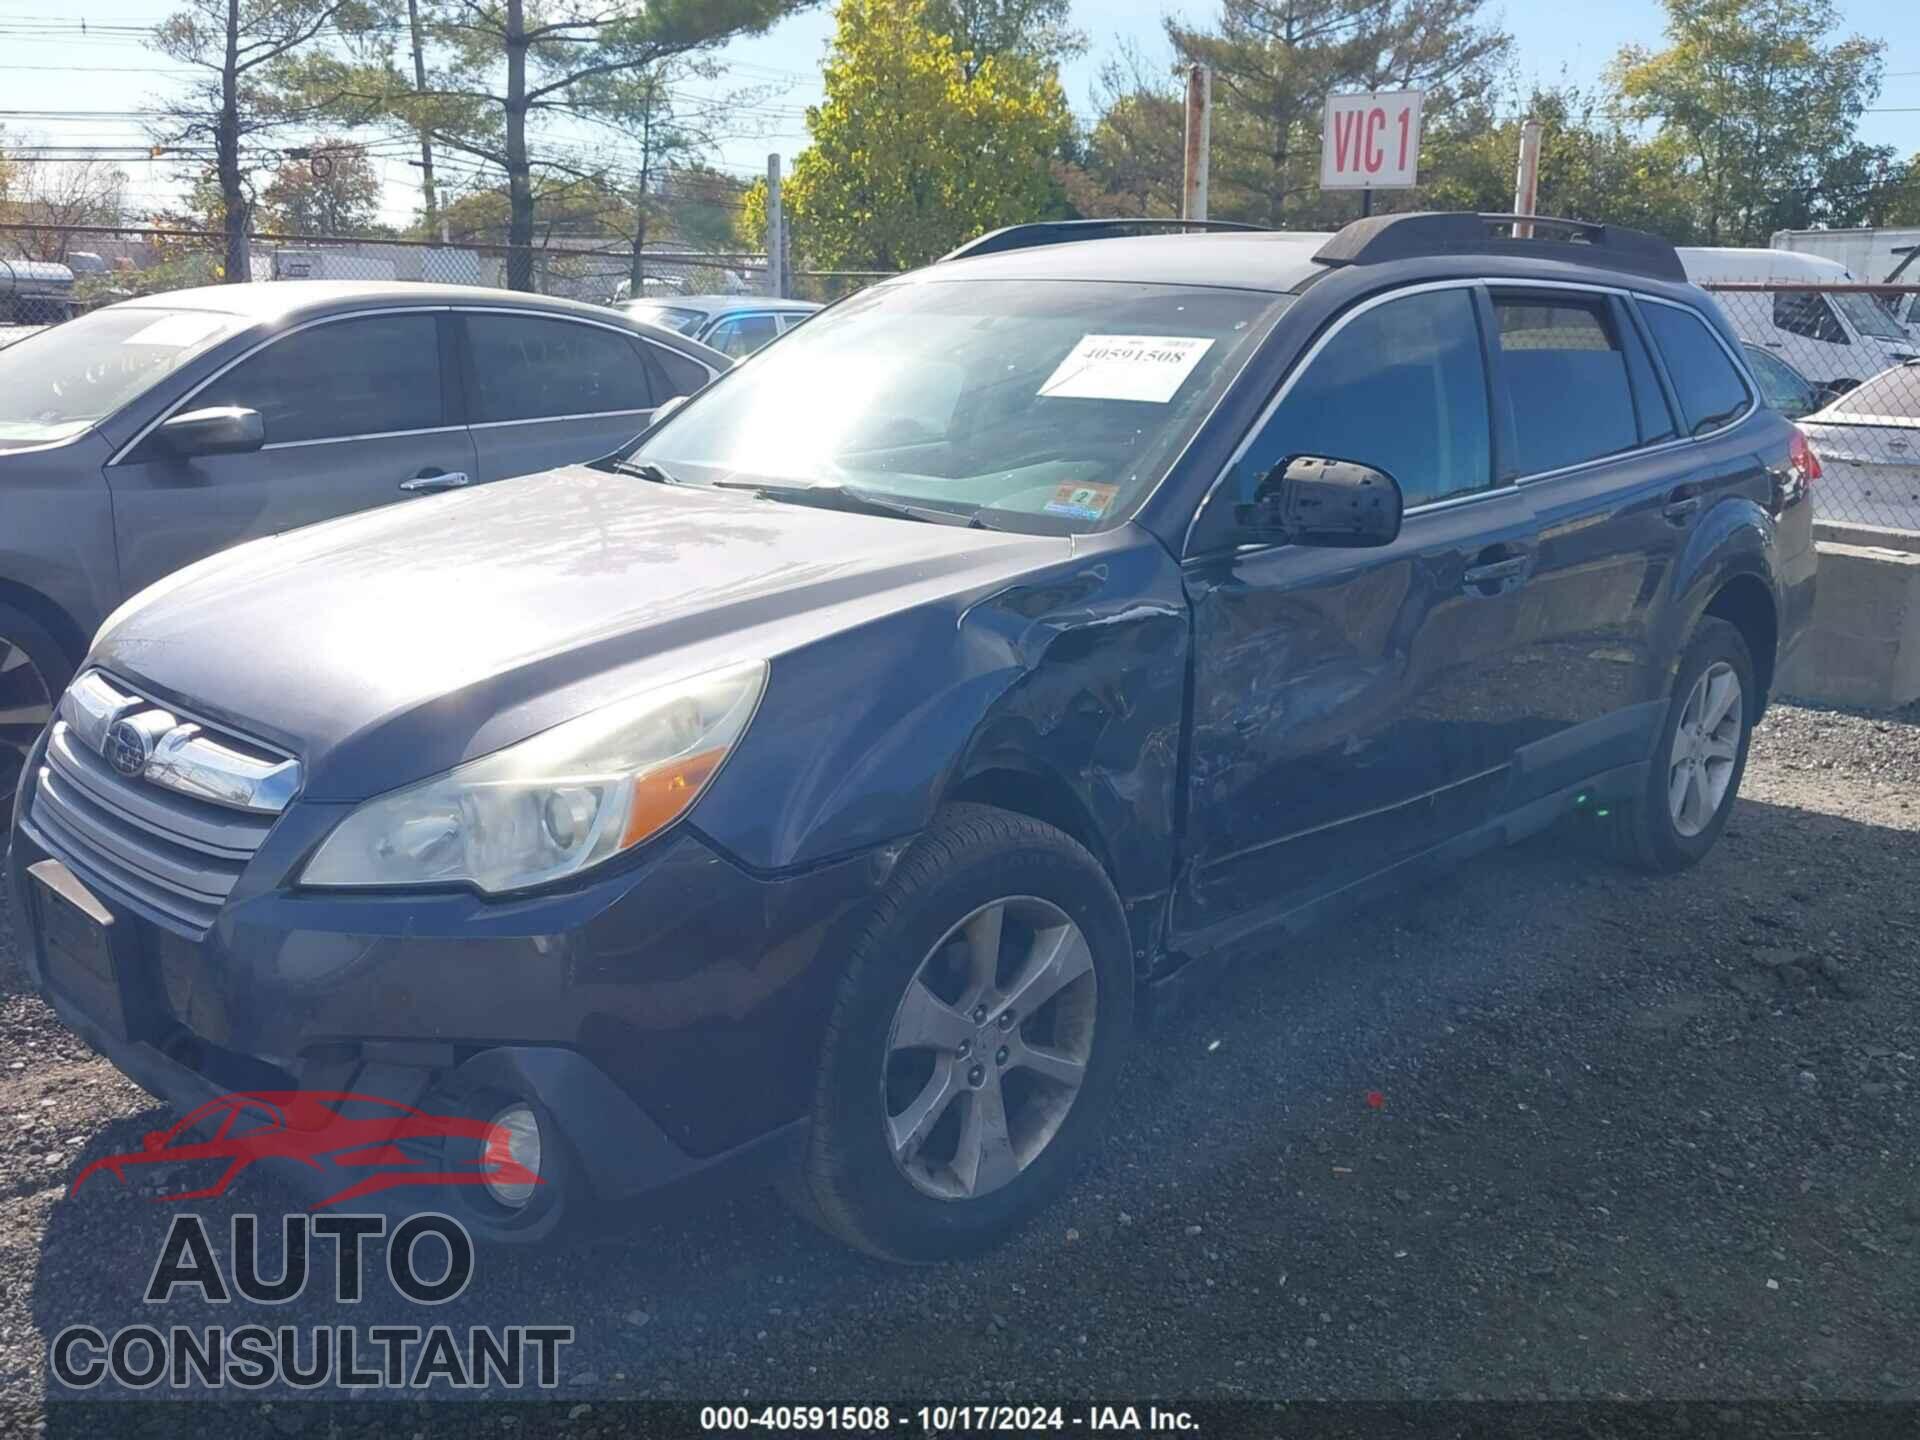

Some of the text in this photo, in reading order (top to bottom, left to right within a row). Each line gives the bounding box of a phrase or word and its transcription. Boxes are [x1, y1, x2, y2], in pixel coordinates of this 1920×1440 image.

[1335, 107, 1410, 173] VIC 1
[1083, 347, 1187, 365] 40591508
